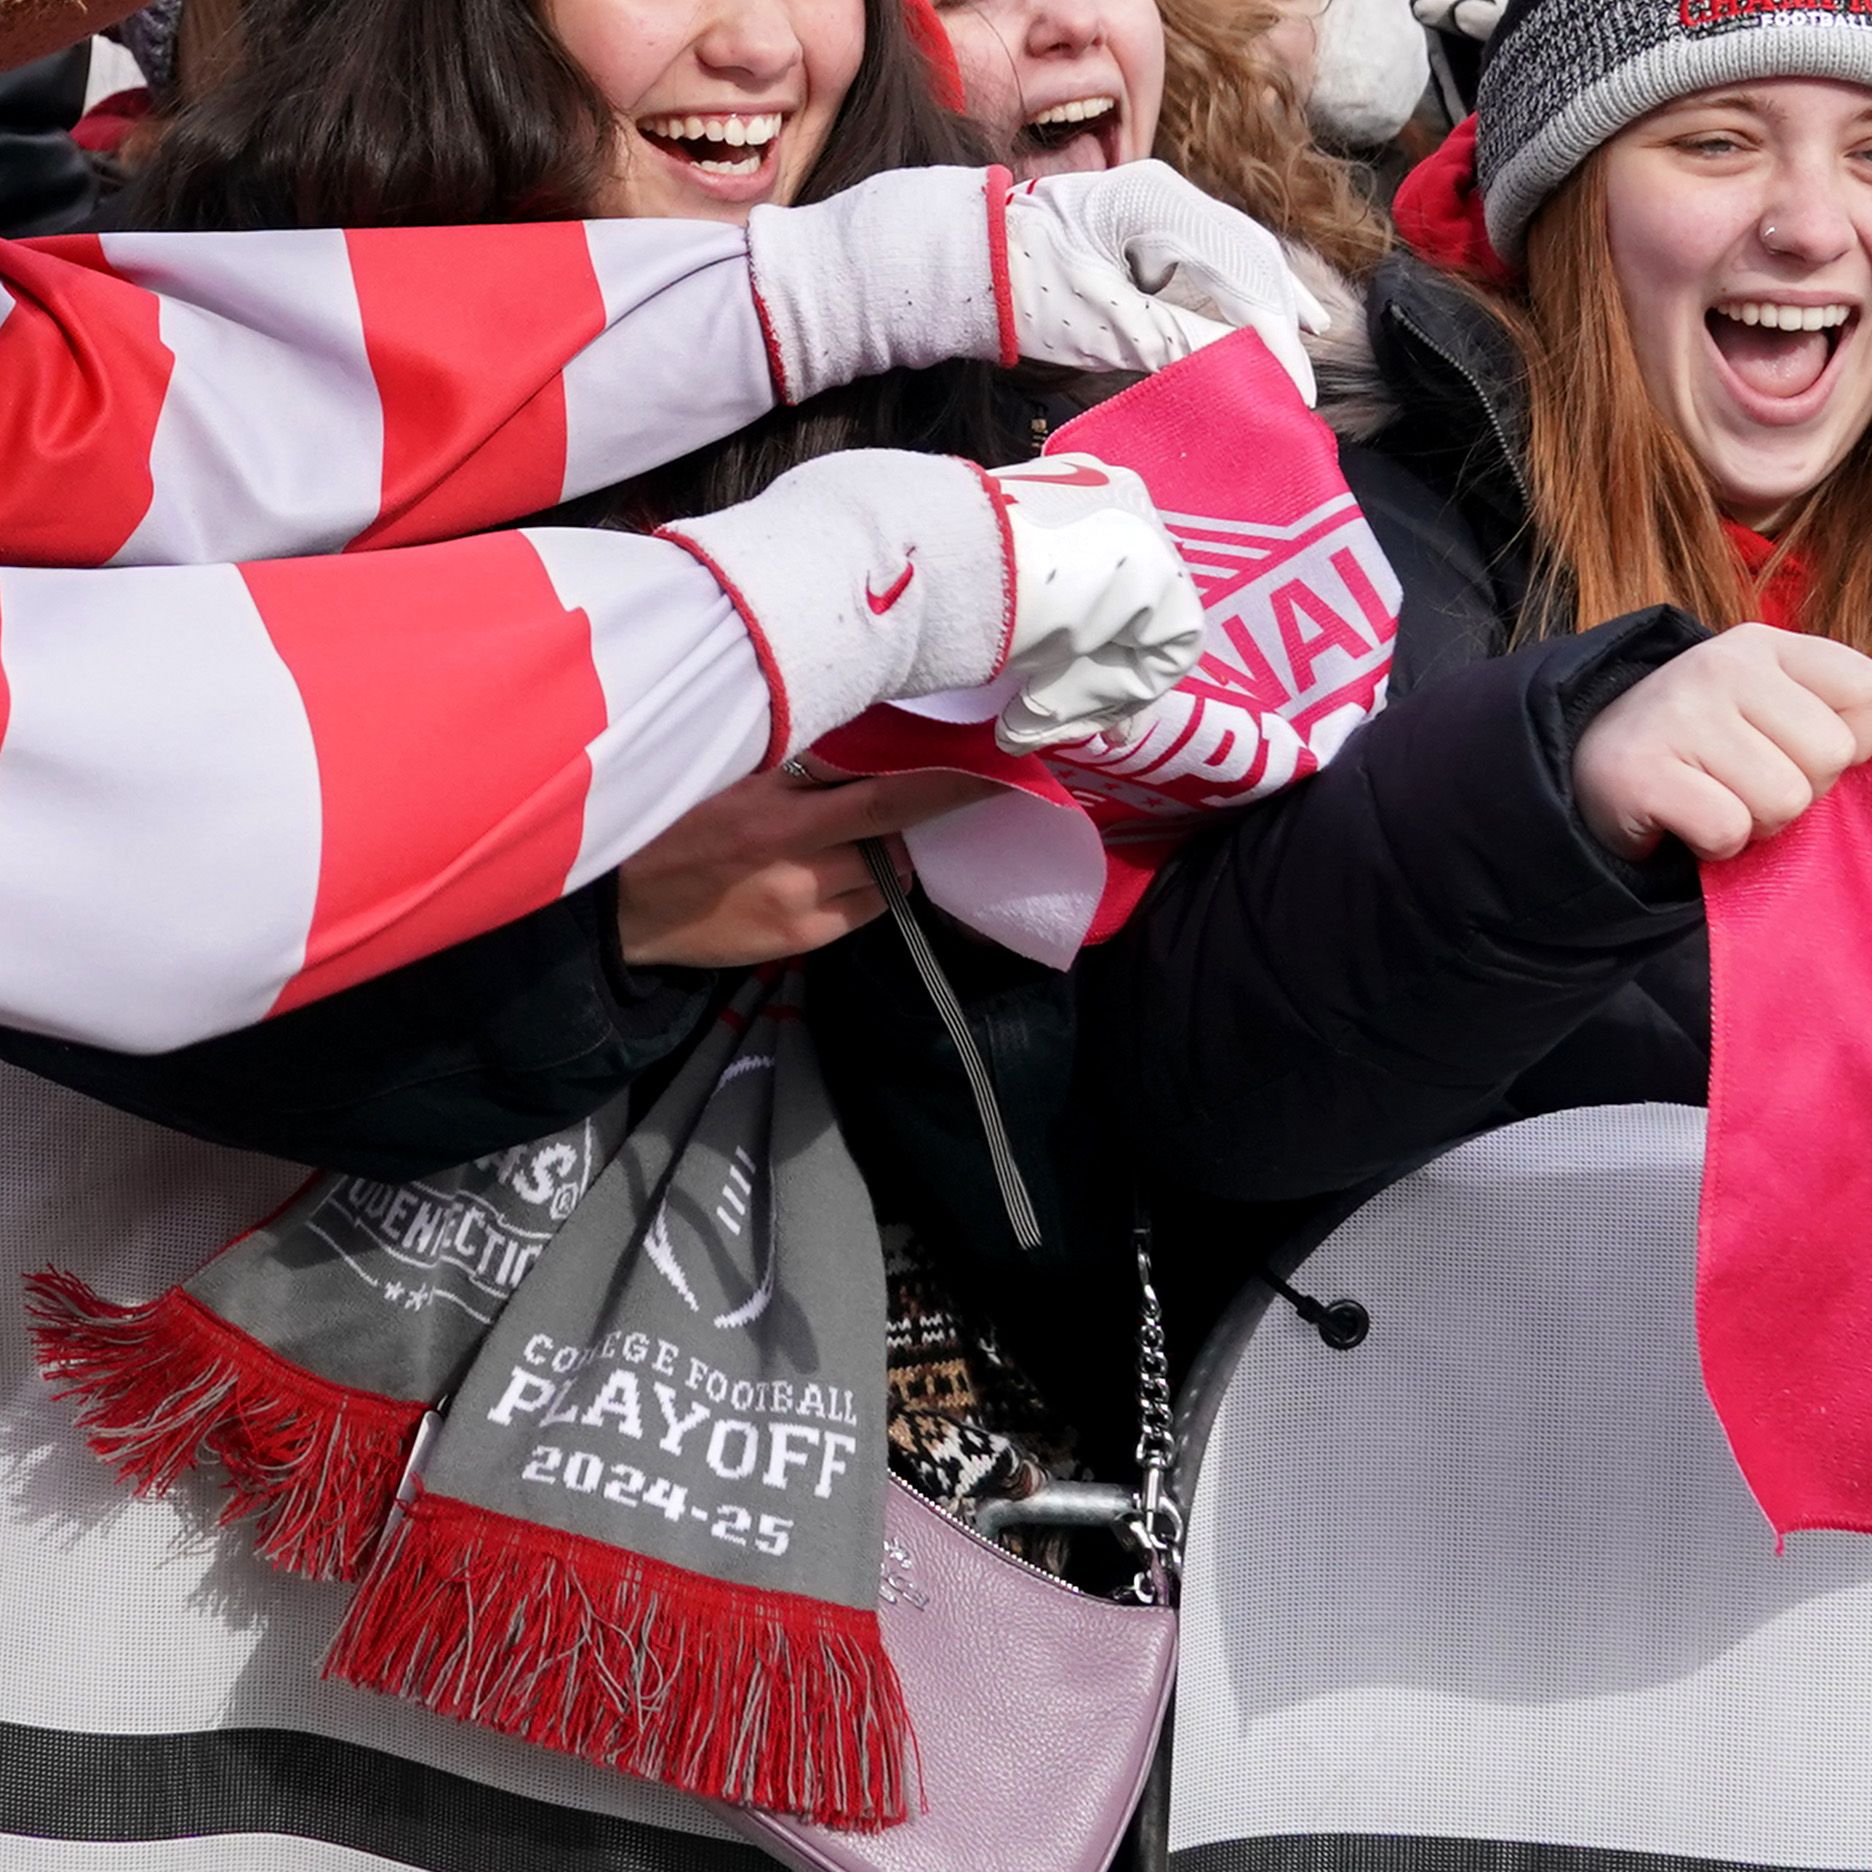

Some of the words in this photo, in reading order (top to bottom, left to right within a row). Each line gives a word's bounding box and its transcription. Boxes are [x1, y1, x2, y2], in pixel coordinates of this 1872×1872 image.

[1759, 12, 1870, 29] FOOTBALL
[487, 1365, 856, 1499] PLAYOFF
[685, 1357, 857, 1426] FOOTBALL
[522, 1445, 794, 1556] 2024-25
